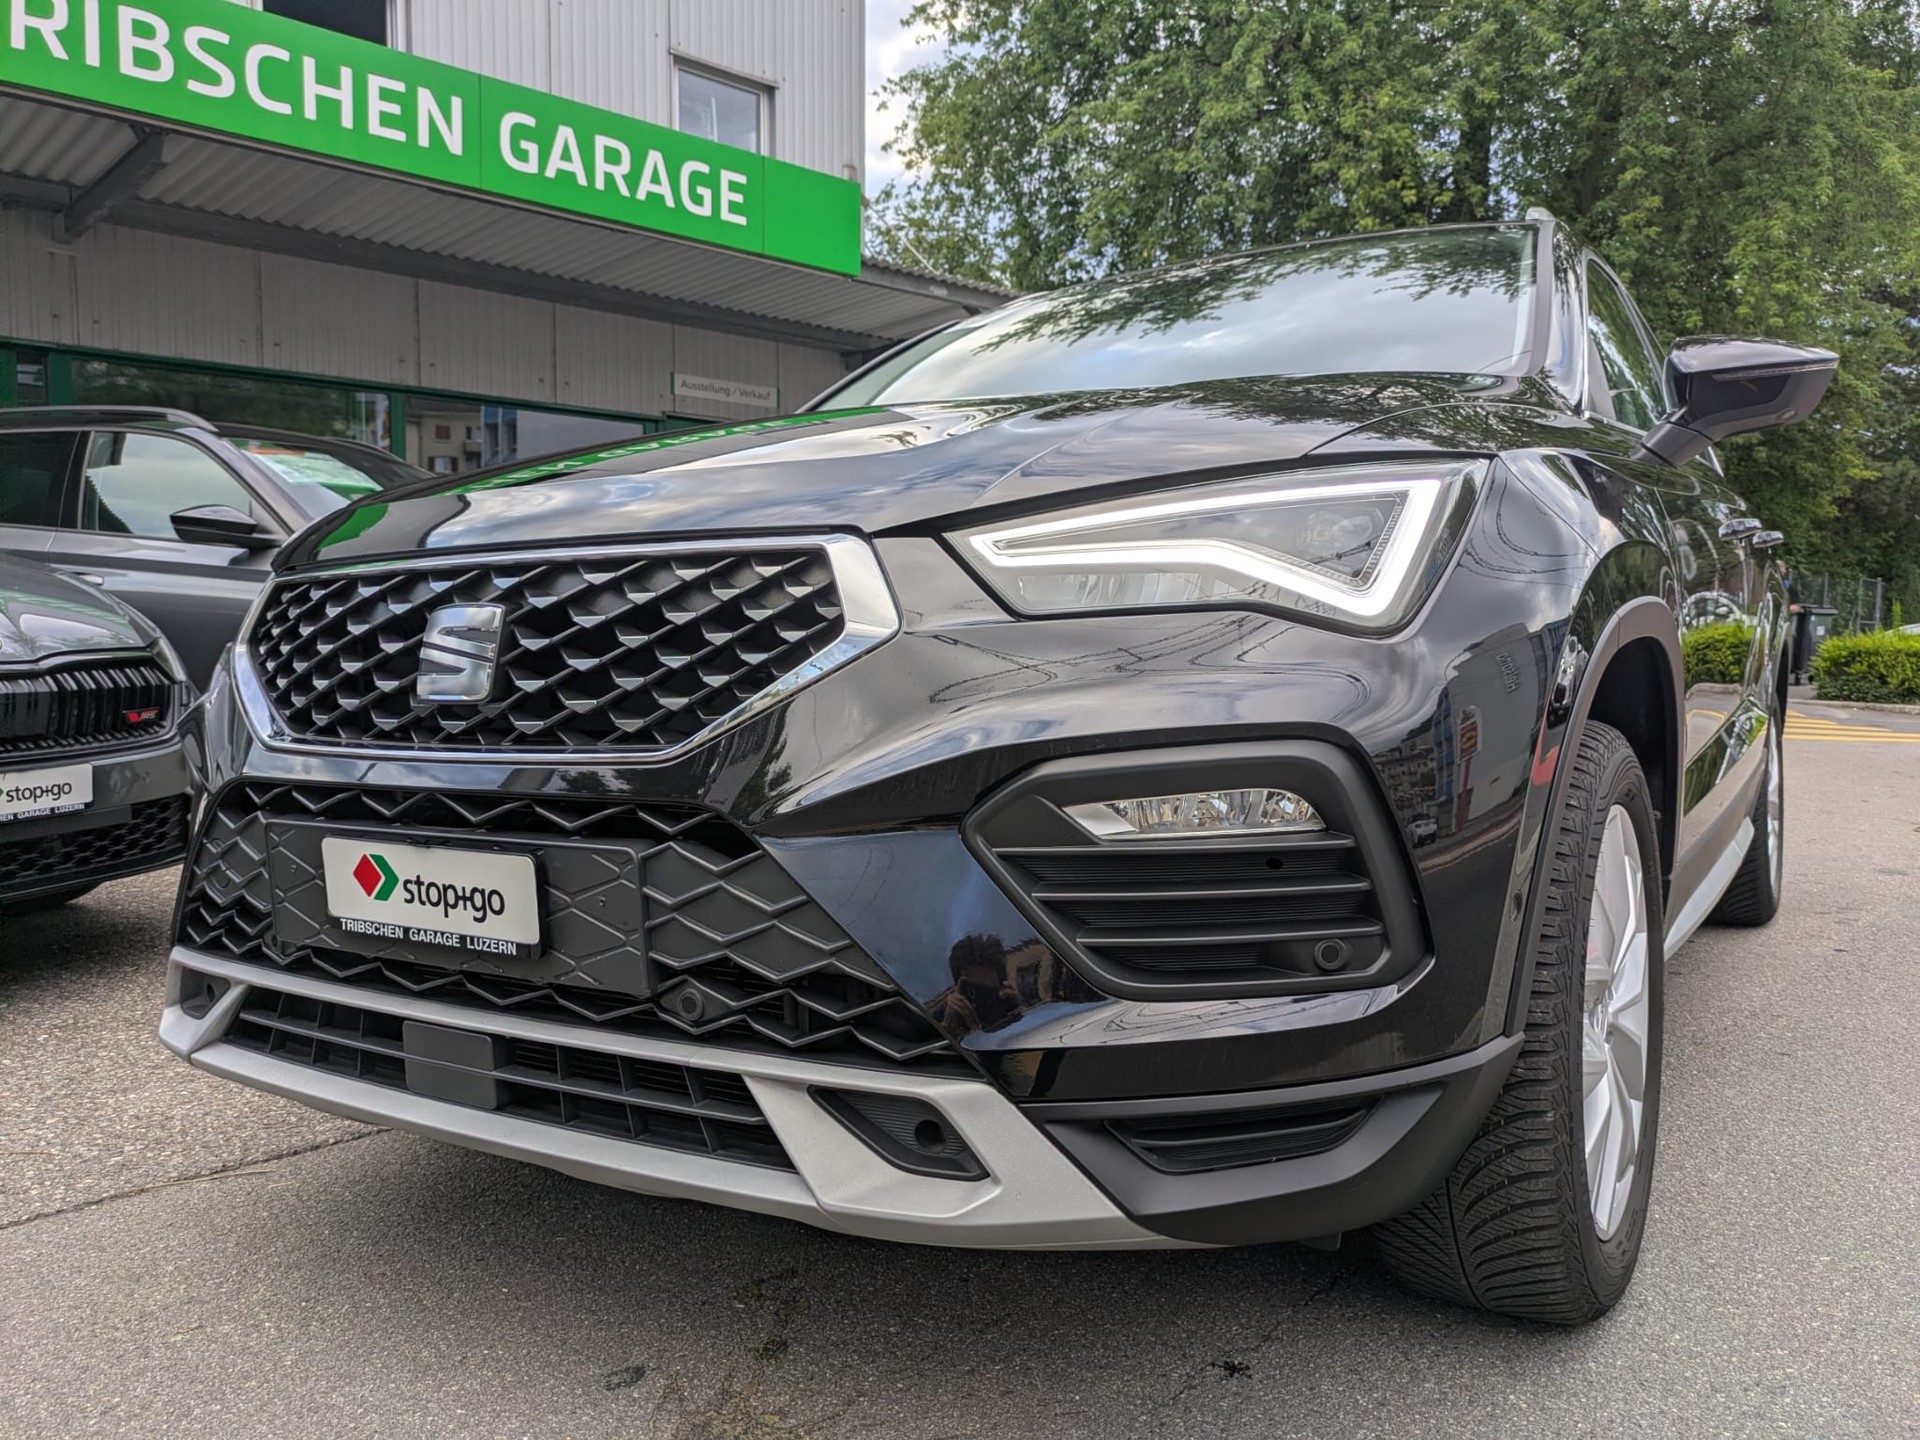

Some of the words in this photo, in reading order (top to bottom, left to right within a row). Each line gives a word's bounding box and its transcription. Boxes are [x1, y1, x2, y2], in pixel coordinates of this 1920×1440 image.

[499, 112, 748, 227] GARAGE
[681, 379, 731, 397] Ausstellung
[739, 389, 771, 401] Verkauf
[6, 782, 72, 803] stop+go
[17, 808, 52, 819] GARAGE
[54, 803, 85, 813] LUZERN
[403, 874, 505, 923] stop+go
[340, 917, 404, 940] TRIBSCHEN
[409, 928, 461, 948] GARAGE
[467, 937, 517, 956] LUZERN
